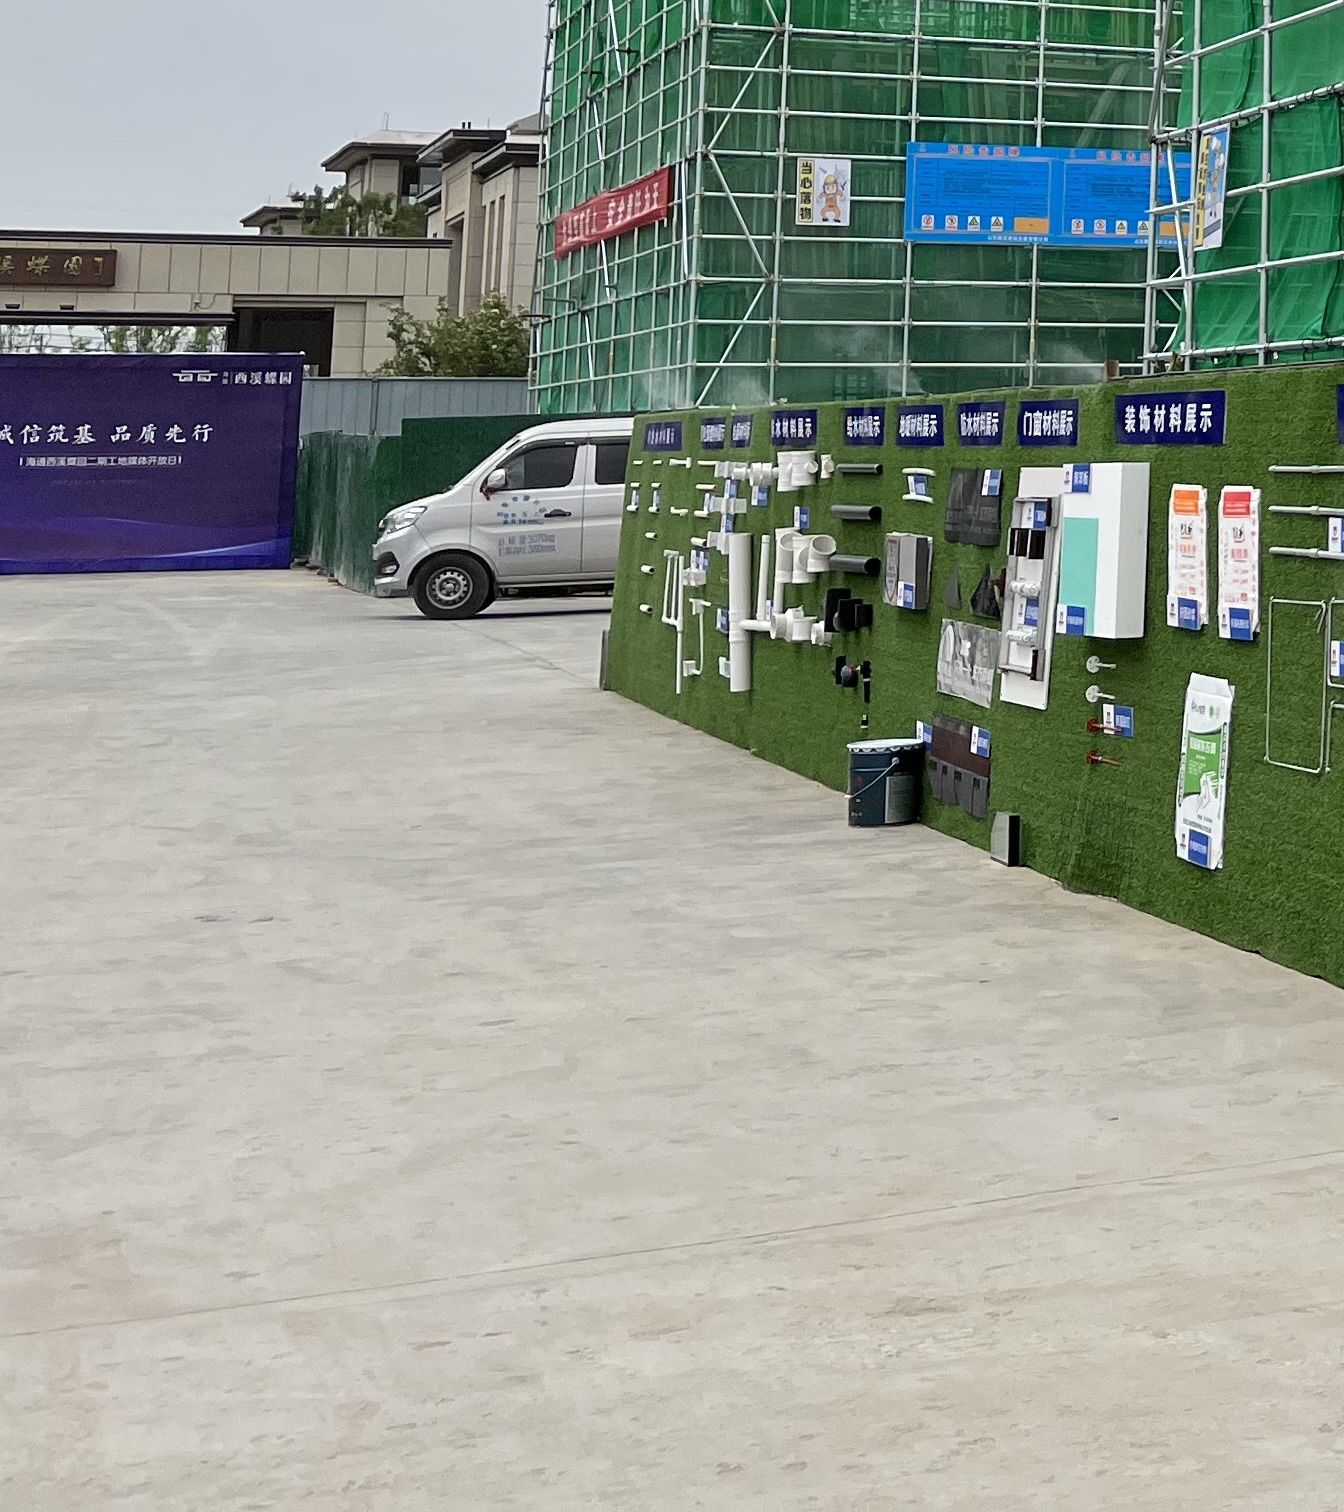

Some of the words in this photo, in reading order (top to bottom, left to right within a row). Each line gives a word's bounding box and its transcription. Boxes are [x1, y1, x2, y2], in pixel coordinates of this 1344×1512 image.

[799, 161, 813, 220] 当心落物
[1023, 409, 1074, 437] 门窗材料展示
[1124, 403, 1213, 434] 装饰材料展示
[110, 423, 214, 444] 品质先行
